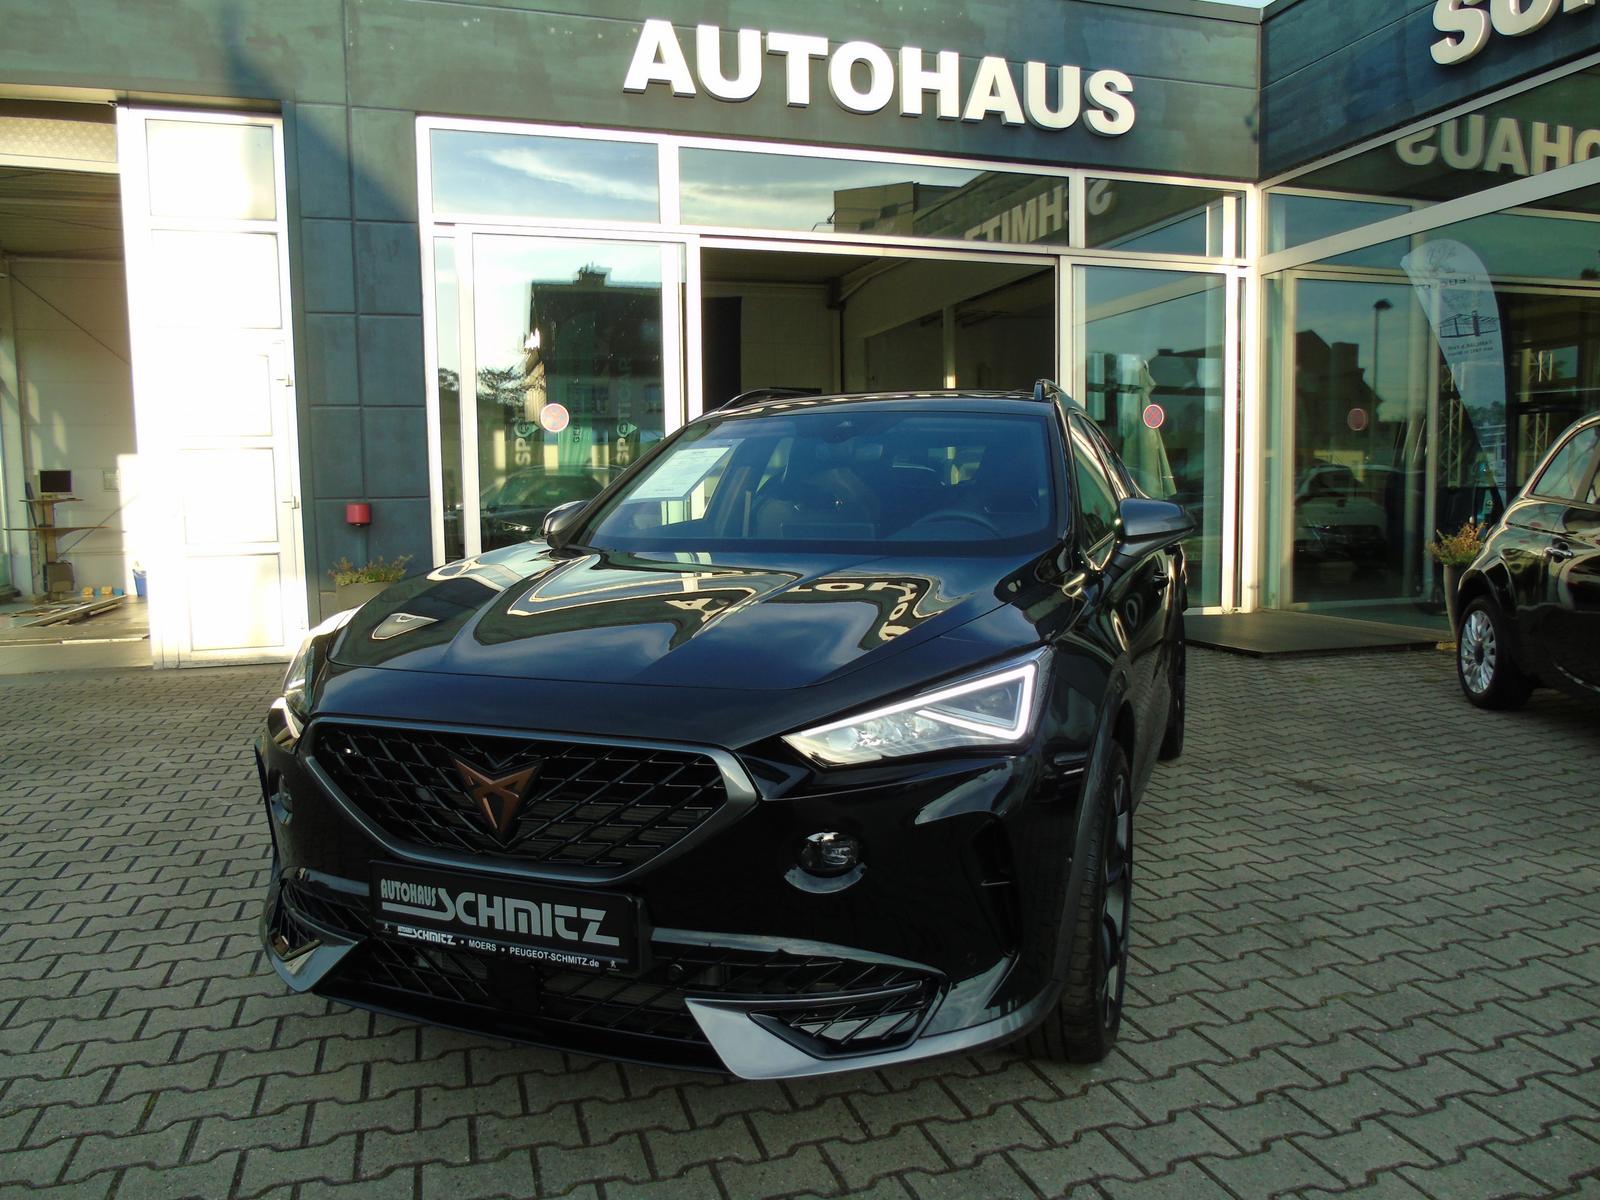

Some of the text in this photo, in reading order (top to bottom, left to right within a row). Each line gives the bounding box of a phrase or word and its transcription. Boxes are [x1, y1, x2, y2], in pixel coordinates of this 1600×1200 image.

[623, 19, 1135, 137] AUTOHAUS
[381, 879, 437, 907] AUTOHAUS
[437, 887, 620, 946] SCHMITZ
[468, 939, 497, 952] MOERS
[509, 946, 600, 968] PEUGEOT-SCHMITZ.de
